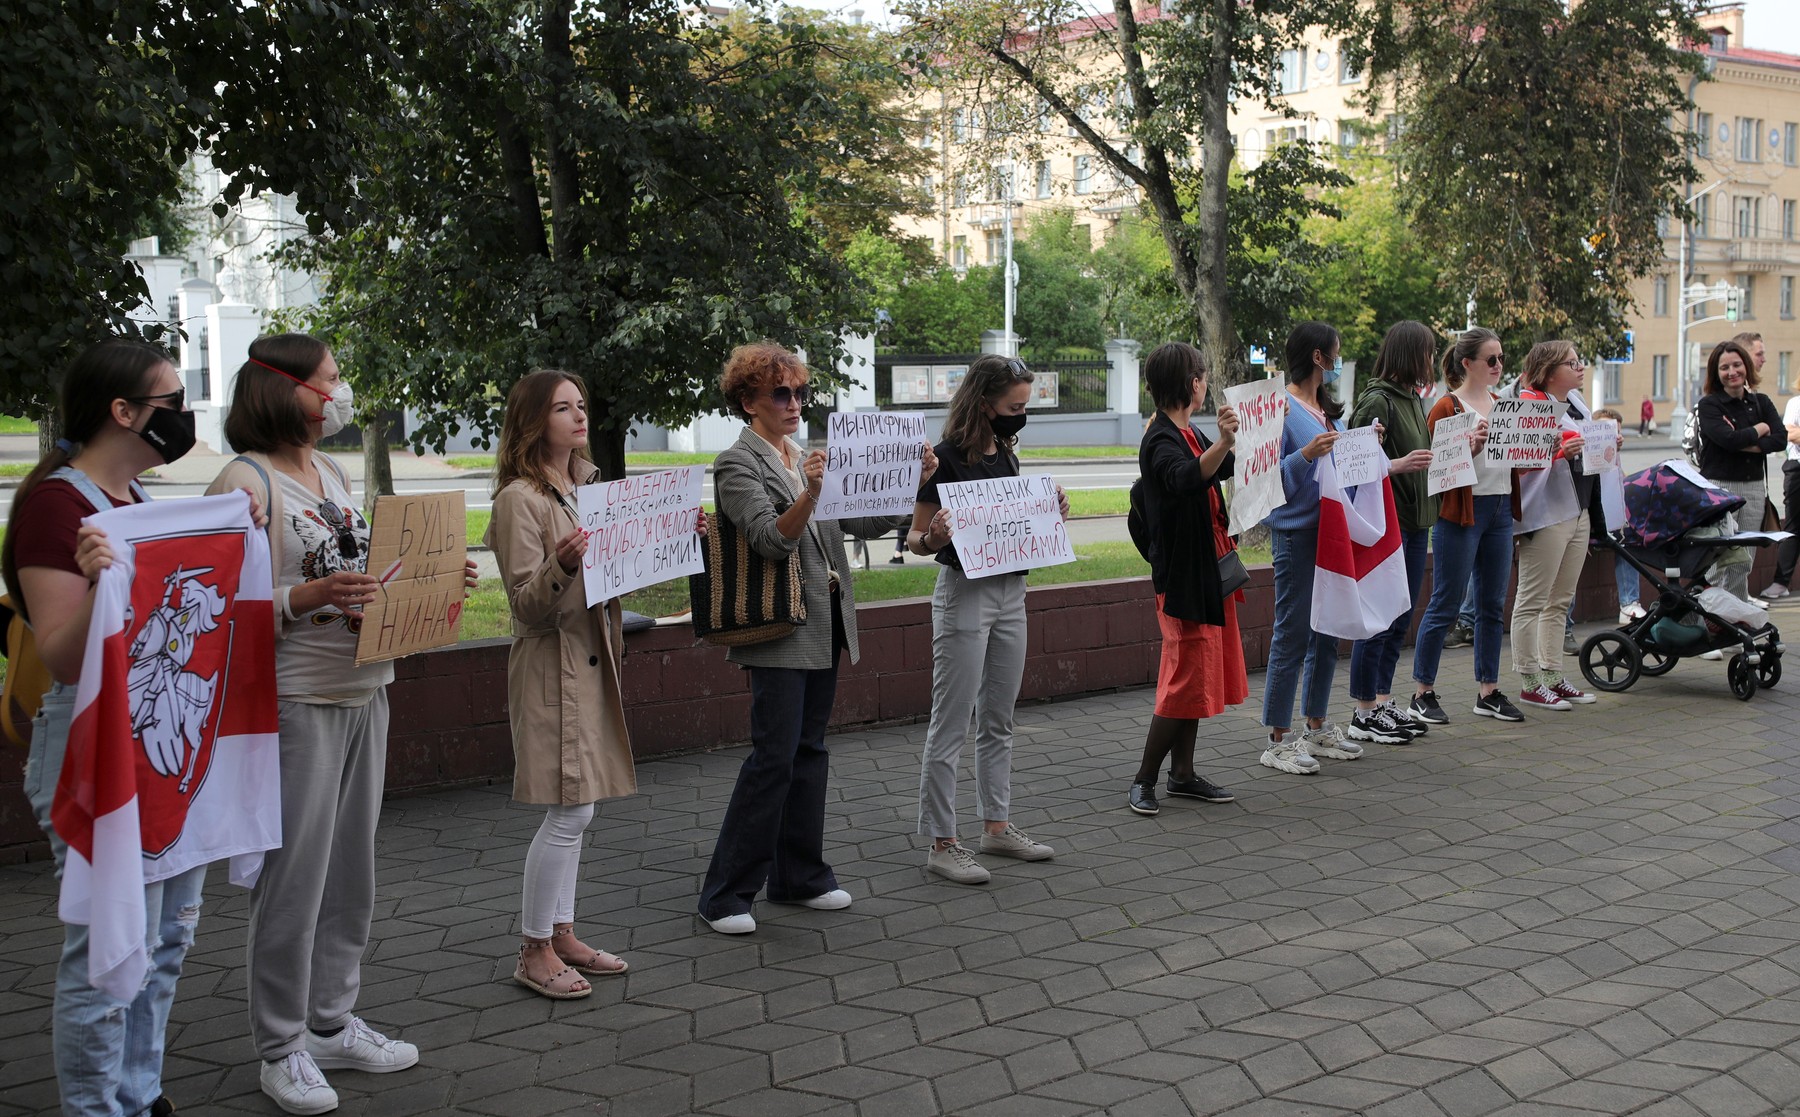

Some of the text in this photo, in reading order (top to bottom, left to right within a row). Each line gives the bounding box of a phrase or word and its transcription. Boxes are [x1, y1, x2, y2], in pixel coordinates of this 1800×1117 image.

[1494, 401, 1553, 414] МГЛУ УЧИЛ
[1492, 418, 1512, 429] НАС
[1487, 445, 1552, 460] МЫ МОЛЧАЛИ!
[1488, 432, 1502, 444] НЕ
[1503, 433, 1519, 444] ДЛЯ
[1523, 433, 1539, 446] ТОГО,
[827, 446, 852, 472] ВЫ
[606, 468, 690, 506] СТУДЕНТАМ
[842, 465, 912, 496] СПАСИБО!
[1343, 467, 1369, 484] МГЛУ
[945, 477, 1057, 509] НАЧАЛЬНИК ПО
[587, 511, 599, 526] ОТ
[823, 502, 839, 515] ОТ
[956, 496, 1056, 530] ВОСПИТАТЕЛЬНОЙ
[399, 501, 455, 557] БУДЬ
[986, 520, 1031, 540] РАБОТЕ
[584, 519, 639, 569] СПАСИБО
[640, 517, 653, 547] ЗА
[963, 521, 1067, 573] ДУБИНКАМИ?
[413, 561, 439, 588] КАК
[603, 533, 698, 593] МЫ С ВАМИ!
[378, 590, 449, 652] НИНА
